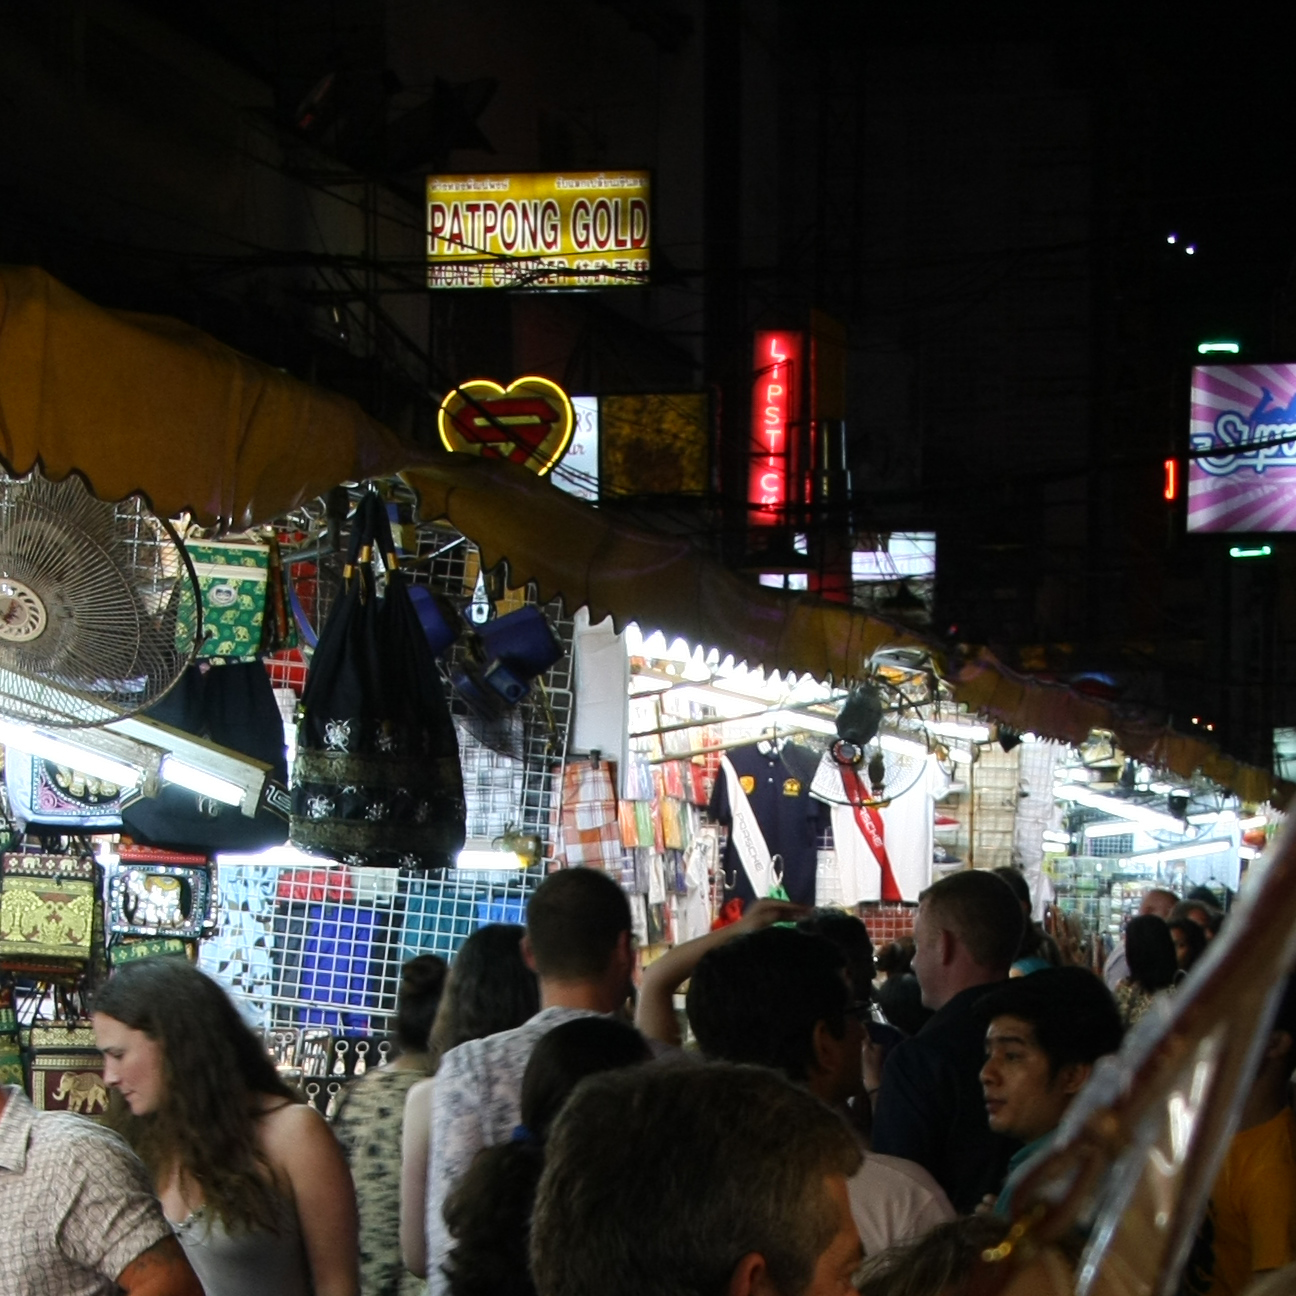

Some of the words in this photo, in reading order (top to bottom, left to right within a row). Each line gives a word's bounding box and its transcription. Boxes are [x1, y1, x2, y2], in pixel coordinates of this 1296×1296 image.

[429, 200, 560, 252] PATPONG
[572, 198, 648, 249] GOLD
[736, 811, 765, 872] PORSCHE
